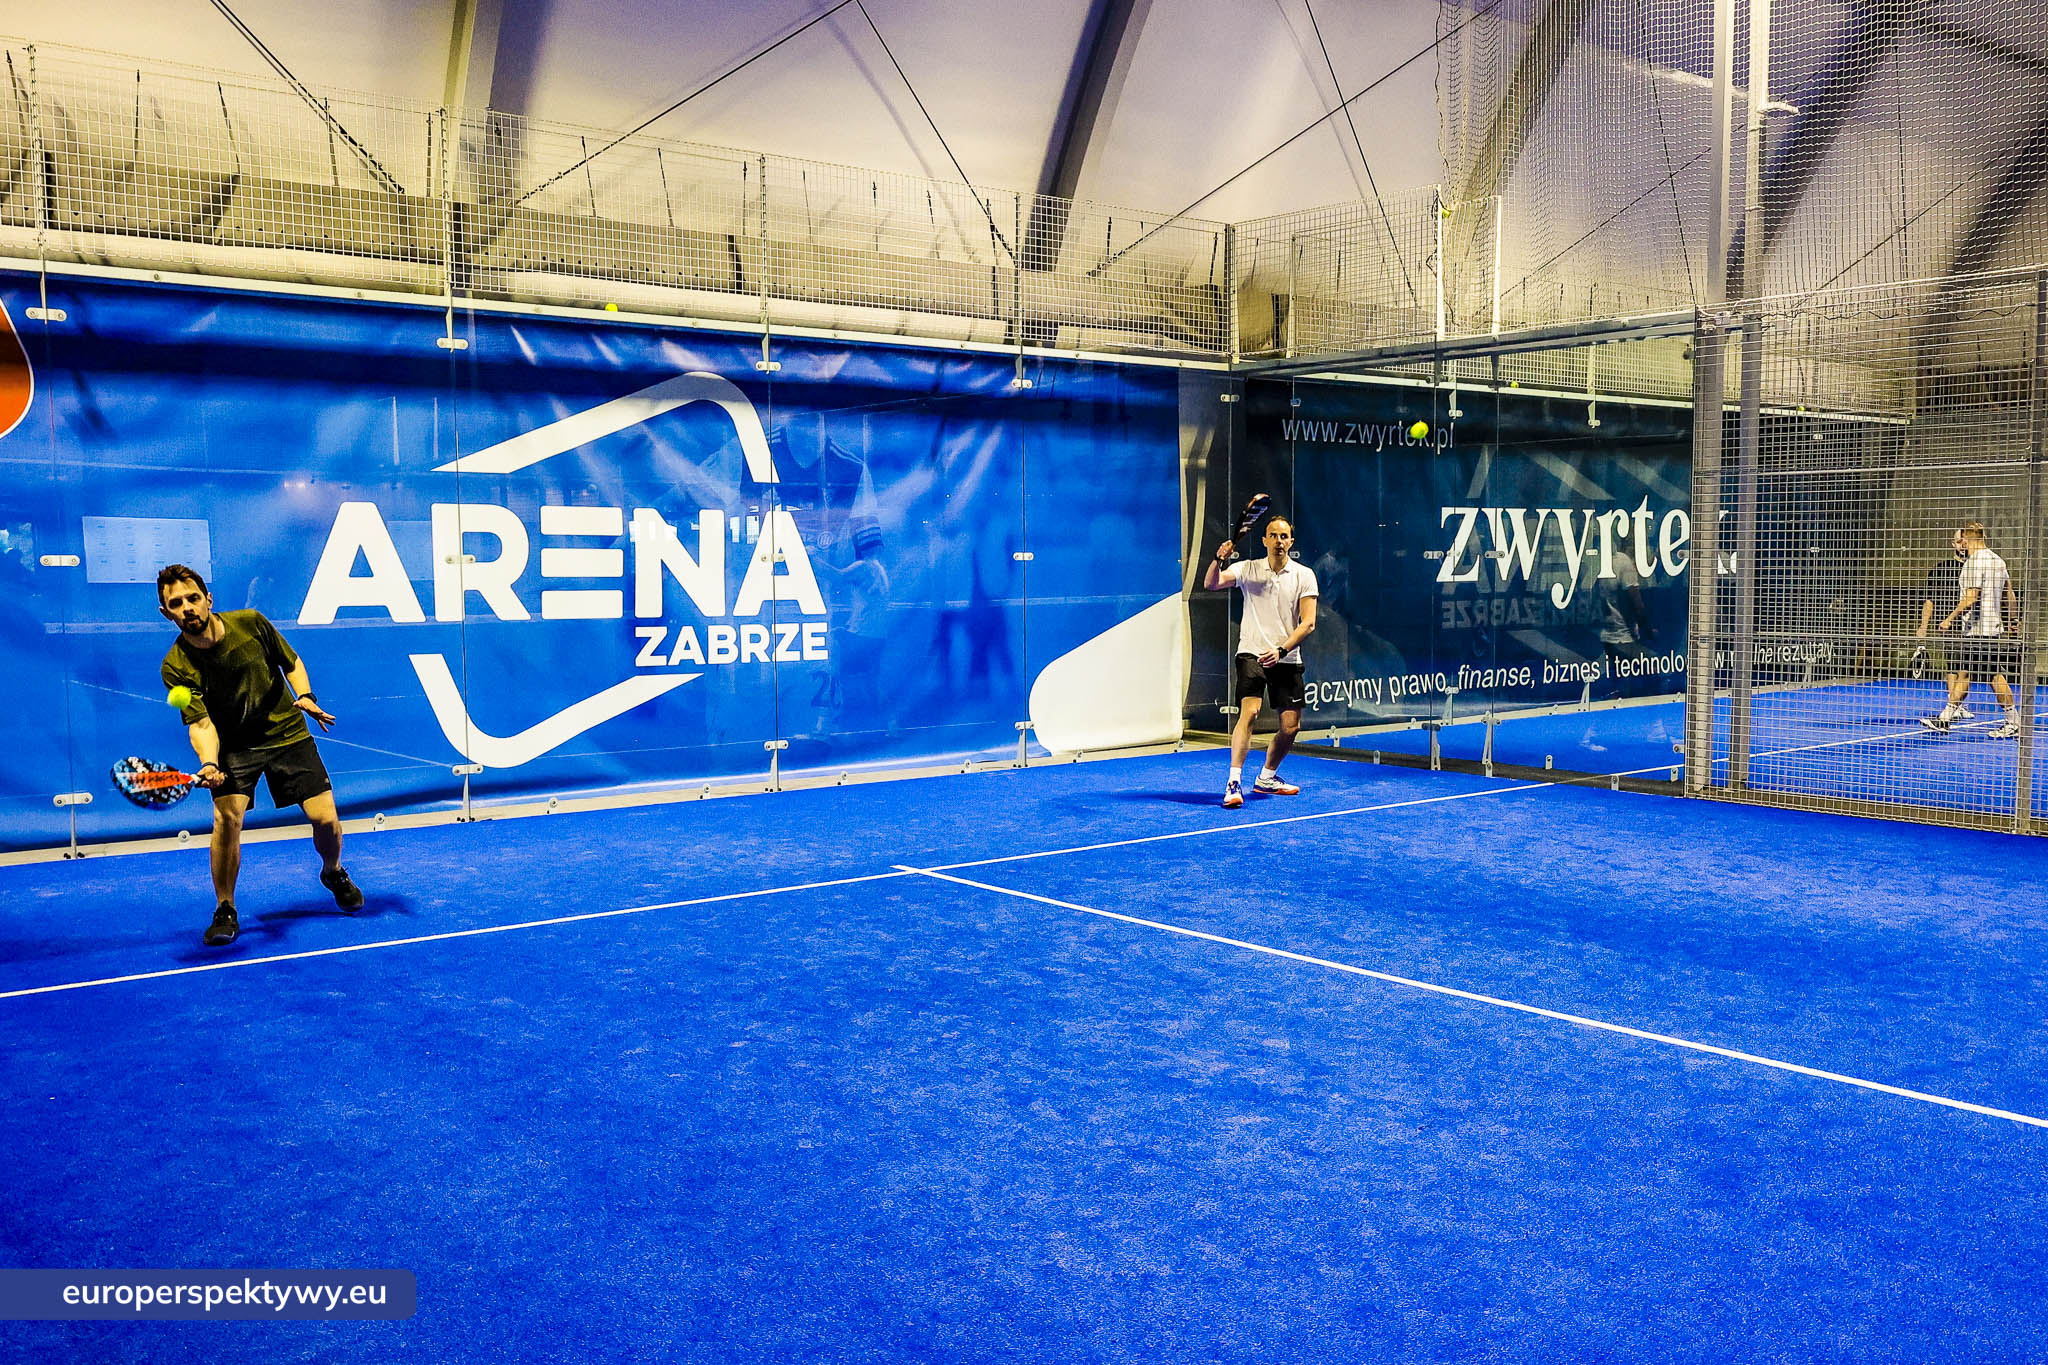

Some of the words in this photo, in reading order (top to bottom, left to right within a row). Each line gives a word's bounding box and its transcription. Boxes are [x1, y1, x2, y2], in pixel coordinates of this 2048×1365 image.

[297, 501, 827, 625] ARENA
[634, 622, 829, 667] ZABRZE
[1304, 677, 1383, 711] ączymy
[1458, 664, 1536, 689] finanse,
[1543, 658, 1601, 684] biznes
[1605, 654, 1610, 679] i
[1614, 650, 1689, 678] technolo
